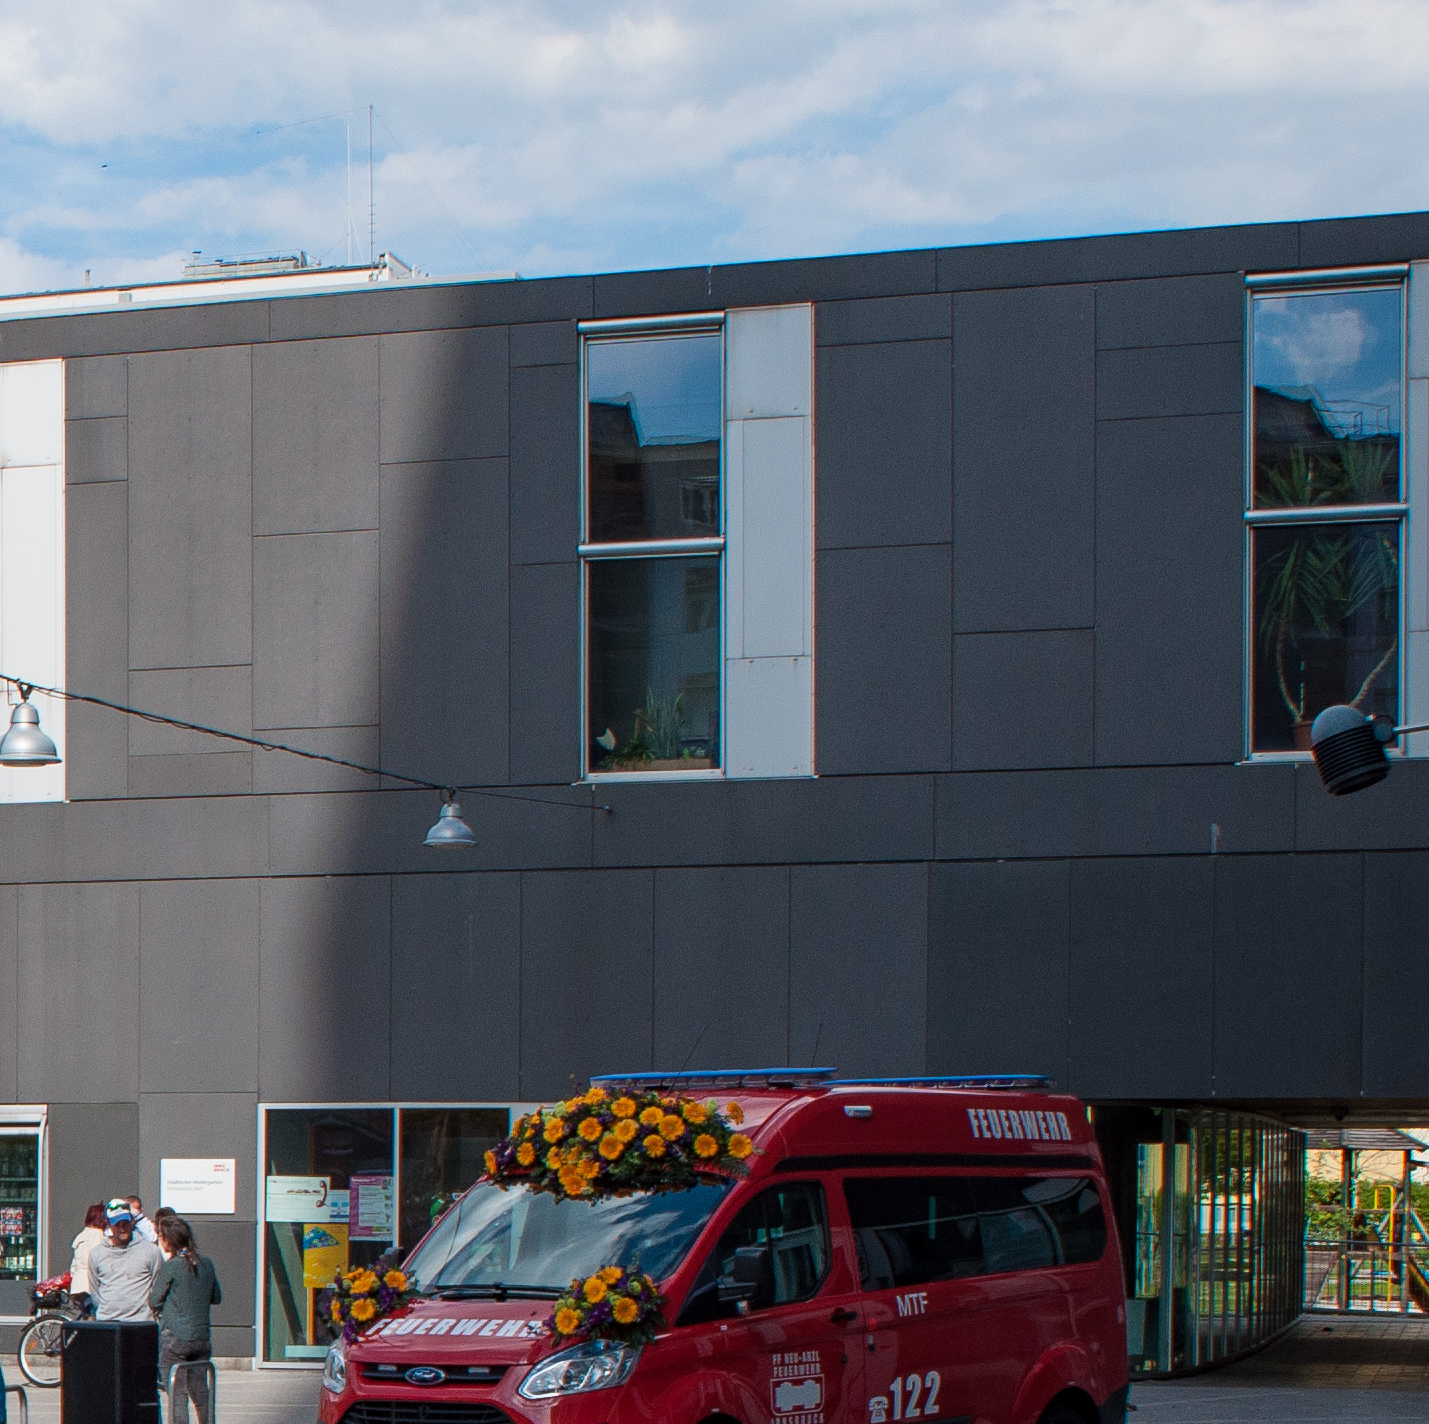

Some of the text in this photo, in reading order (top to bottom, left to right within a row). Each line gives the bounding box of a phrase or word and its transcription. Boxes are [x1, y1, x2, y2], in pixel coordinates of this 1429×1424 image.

[967, 1108, 1072, 1140] FEUERWEHR
[896, 1292, 928, 1317] MTF
[773, 1363, 821, 1377] FEUERWEHR
[889, 1370, 941, 1421] 122
